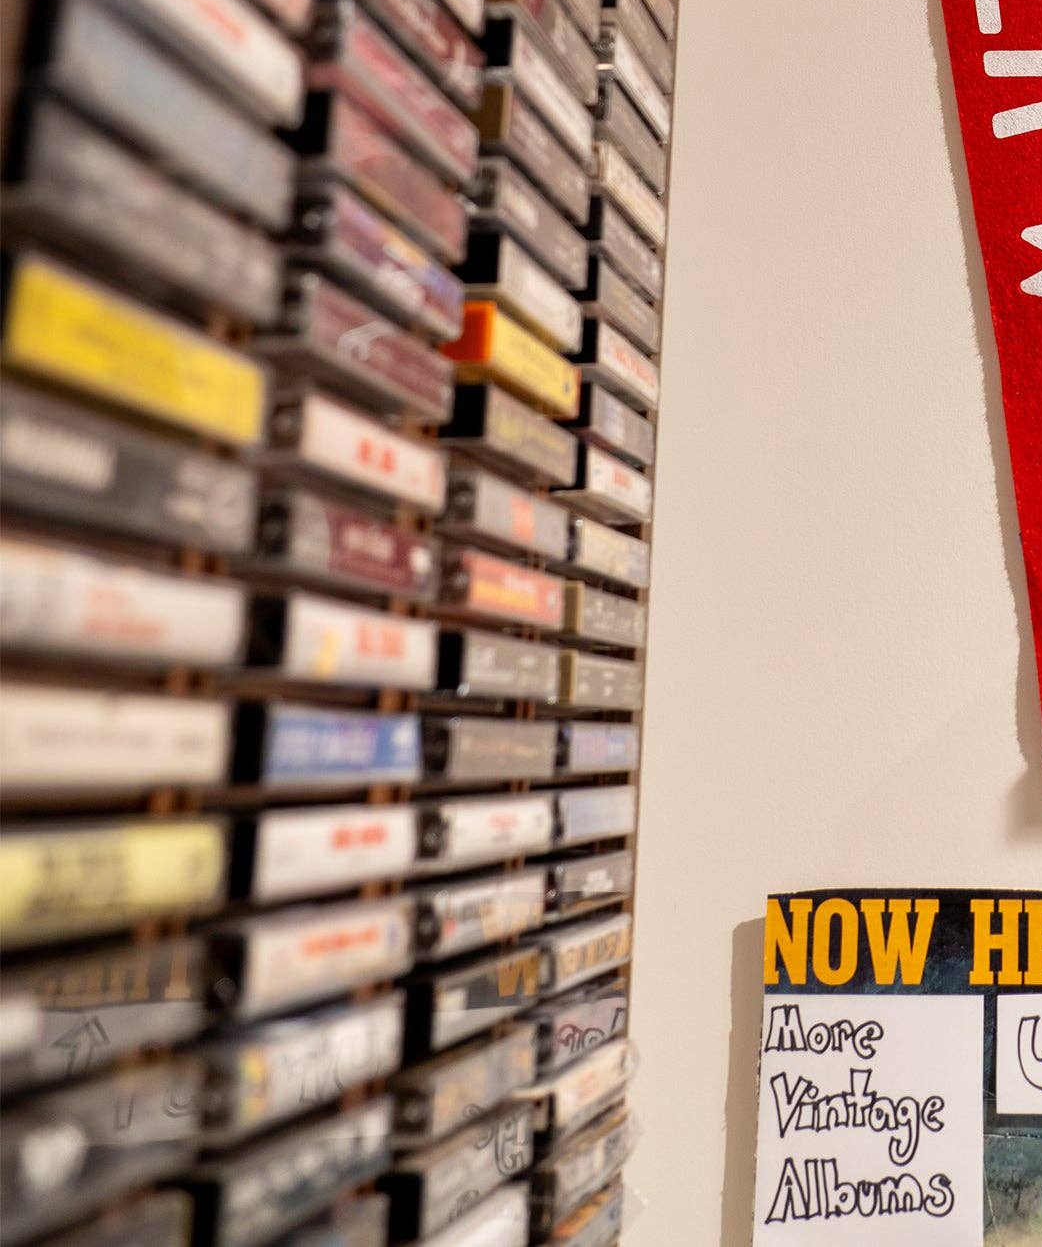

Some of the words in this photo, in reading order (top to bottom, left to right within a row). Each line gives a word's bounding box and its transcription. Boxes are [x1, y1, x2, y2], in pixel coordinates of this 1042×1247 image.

[764, 898, 940, 986] NOW
[764, 1004, 884, 1060] More
[770, 1068, 945, 1166] Vintage
[764, 1157, 955, 1224] Albums
